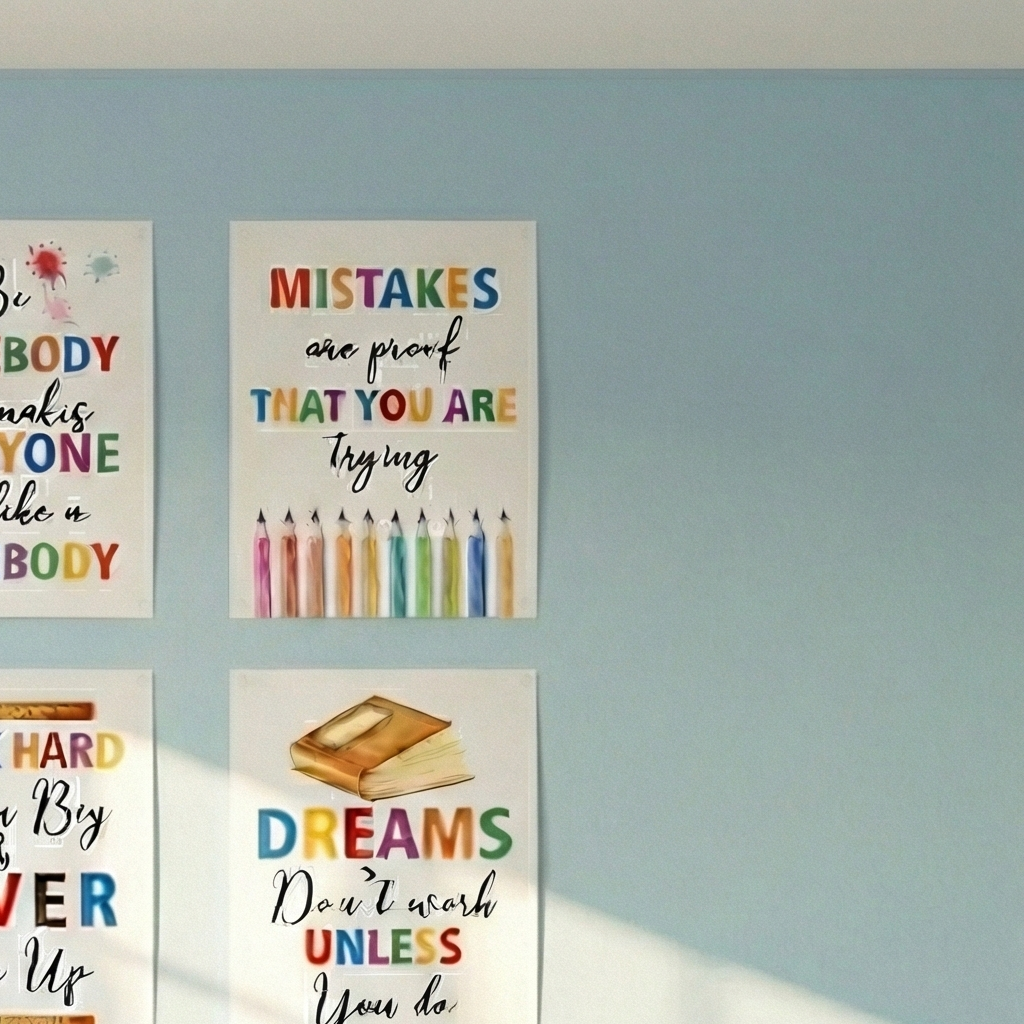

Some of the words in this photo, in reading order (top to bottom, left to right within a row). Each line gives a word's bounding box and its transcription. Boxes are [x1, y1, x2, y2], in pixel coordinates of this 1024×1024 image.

[270, 266, 498, 309] MISTAKES
[355, 388, 433, 425] YOU
[442, 387, 517, 425] ARE
[13, 732, 124, 770] HARD
[259, 806, 512, 860] DREAMS
[305, 927, 462, 967] UNLESS
[25, 937, 94, 1006] Up
[414, 975, 457, 1016] do
